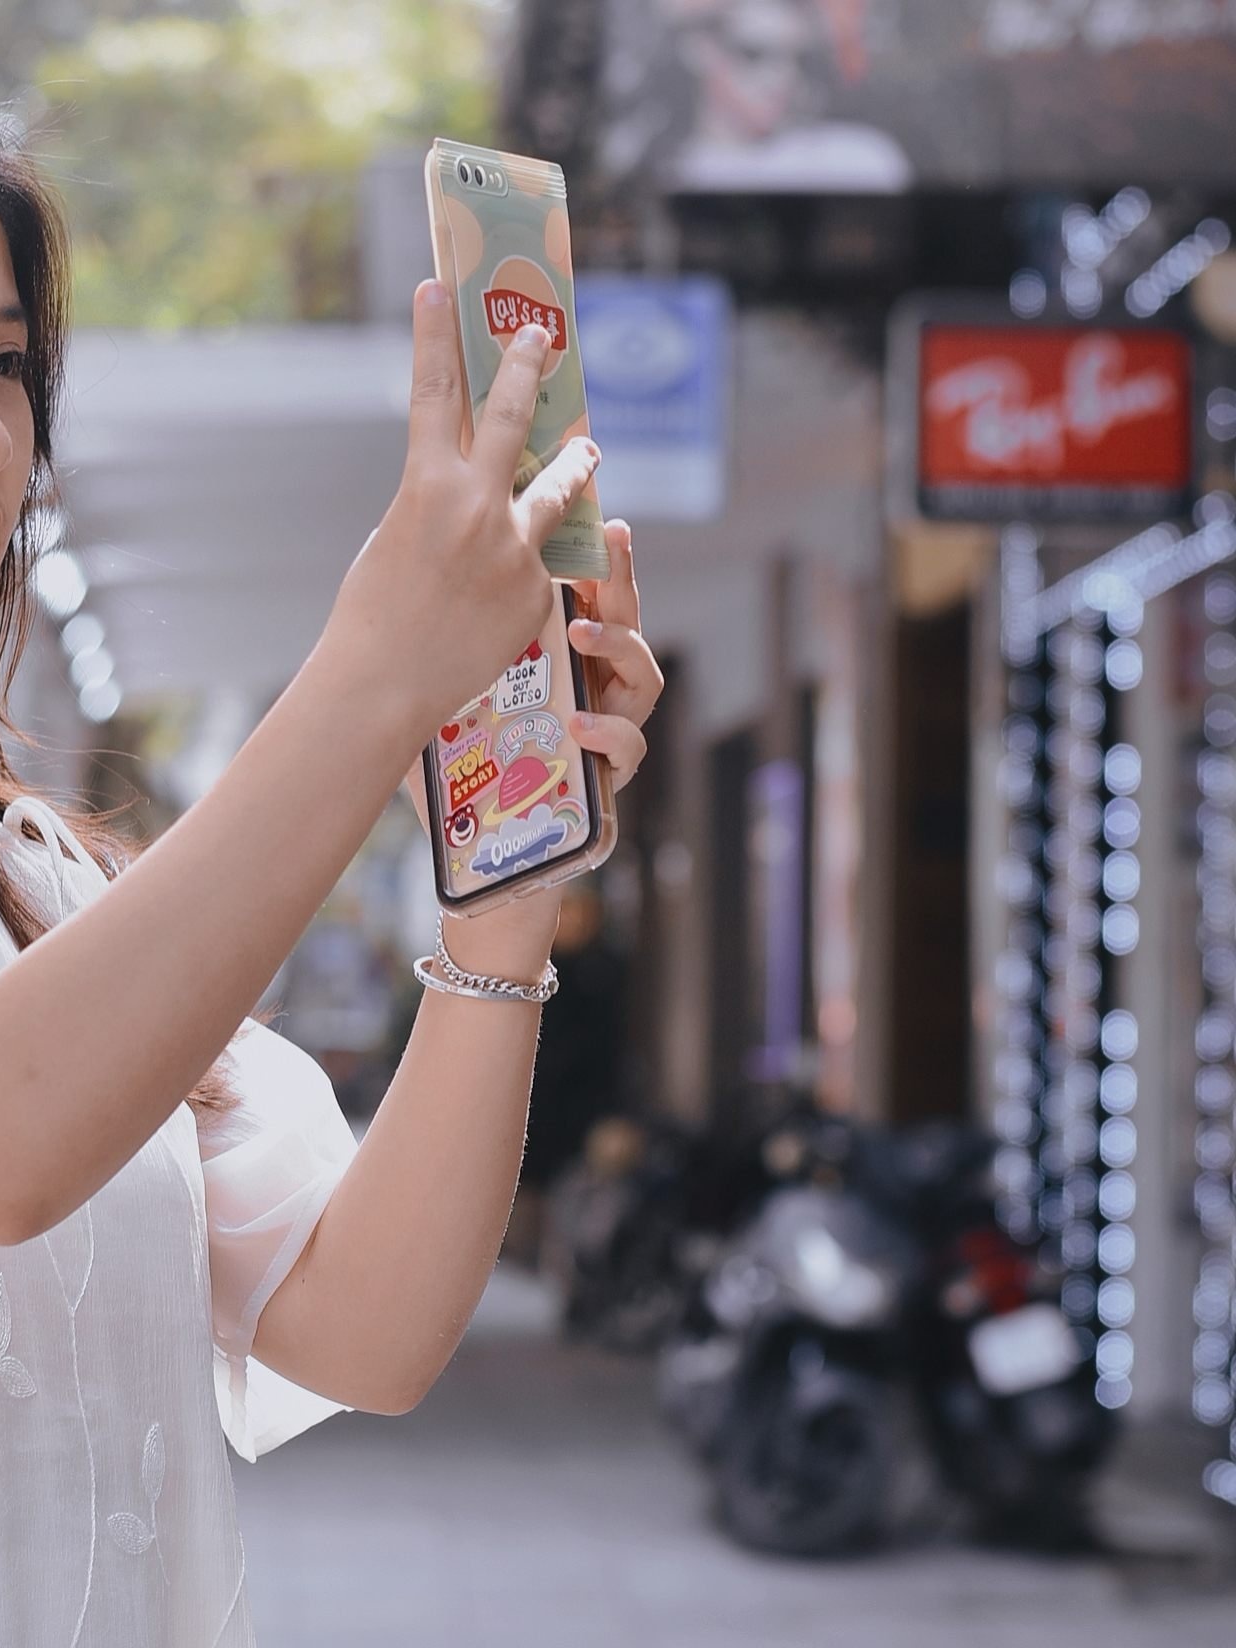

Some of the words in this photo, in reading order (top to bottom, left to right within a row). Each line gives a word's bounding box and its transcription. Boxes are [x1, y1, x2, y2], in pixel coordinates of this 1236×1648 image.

[490, 295, 530, 329] Lay's
[506, 664, 537, 683] LOOK
[513, 679, 531, 693] OUT
[502, 688, 542, 709] LOTSO
[444, 737, 488, 784] TOY
[453, 763, 494, 802] STORY
